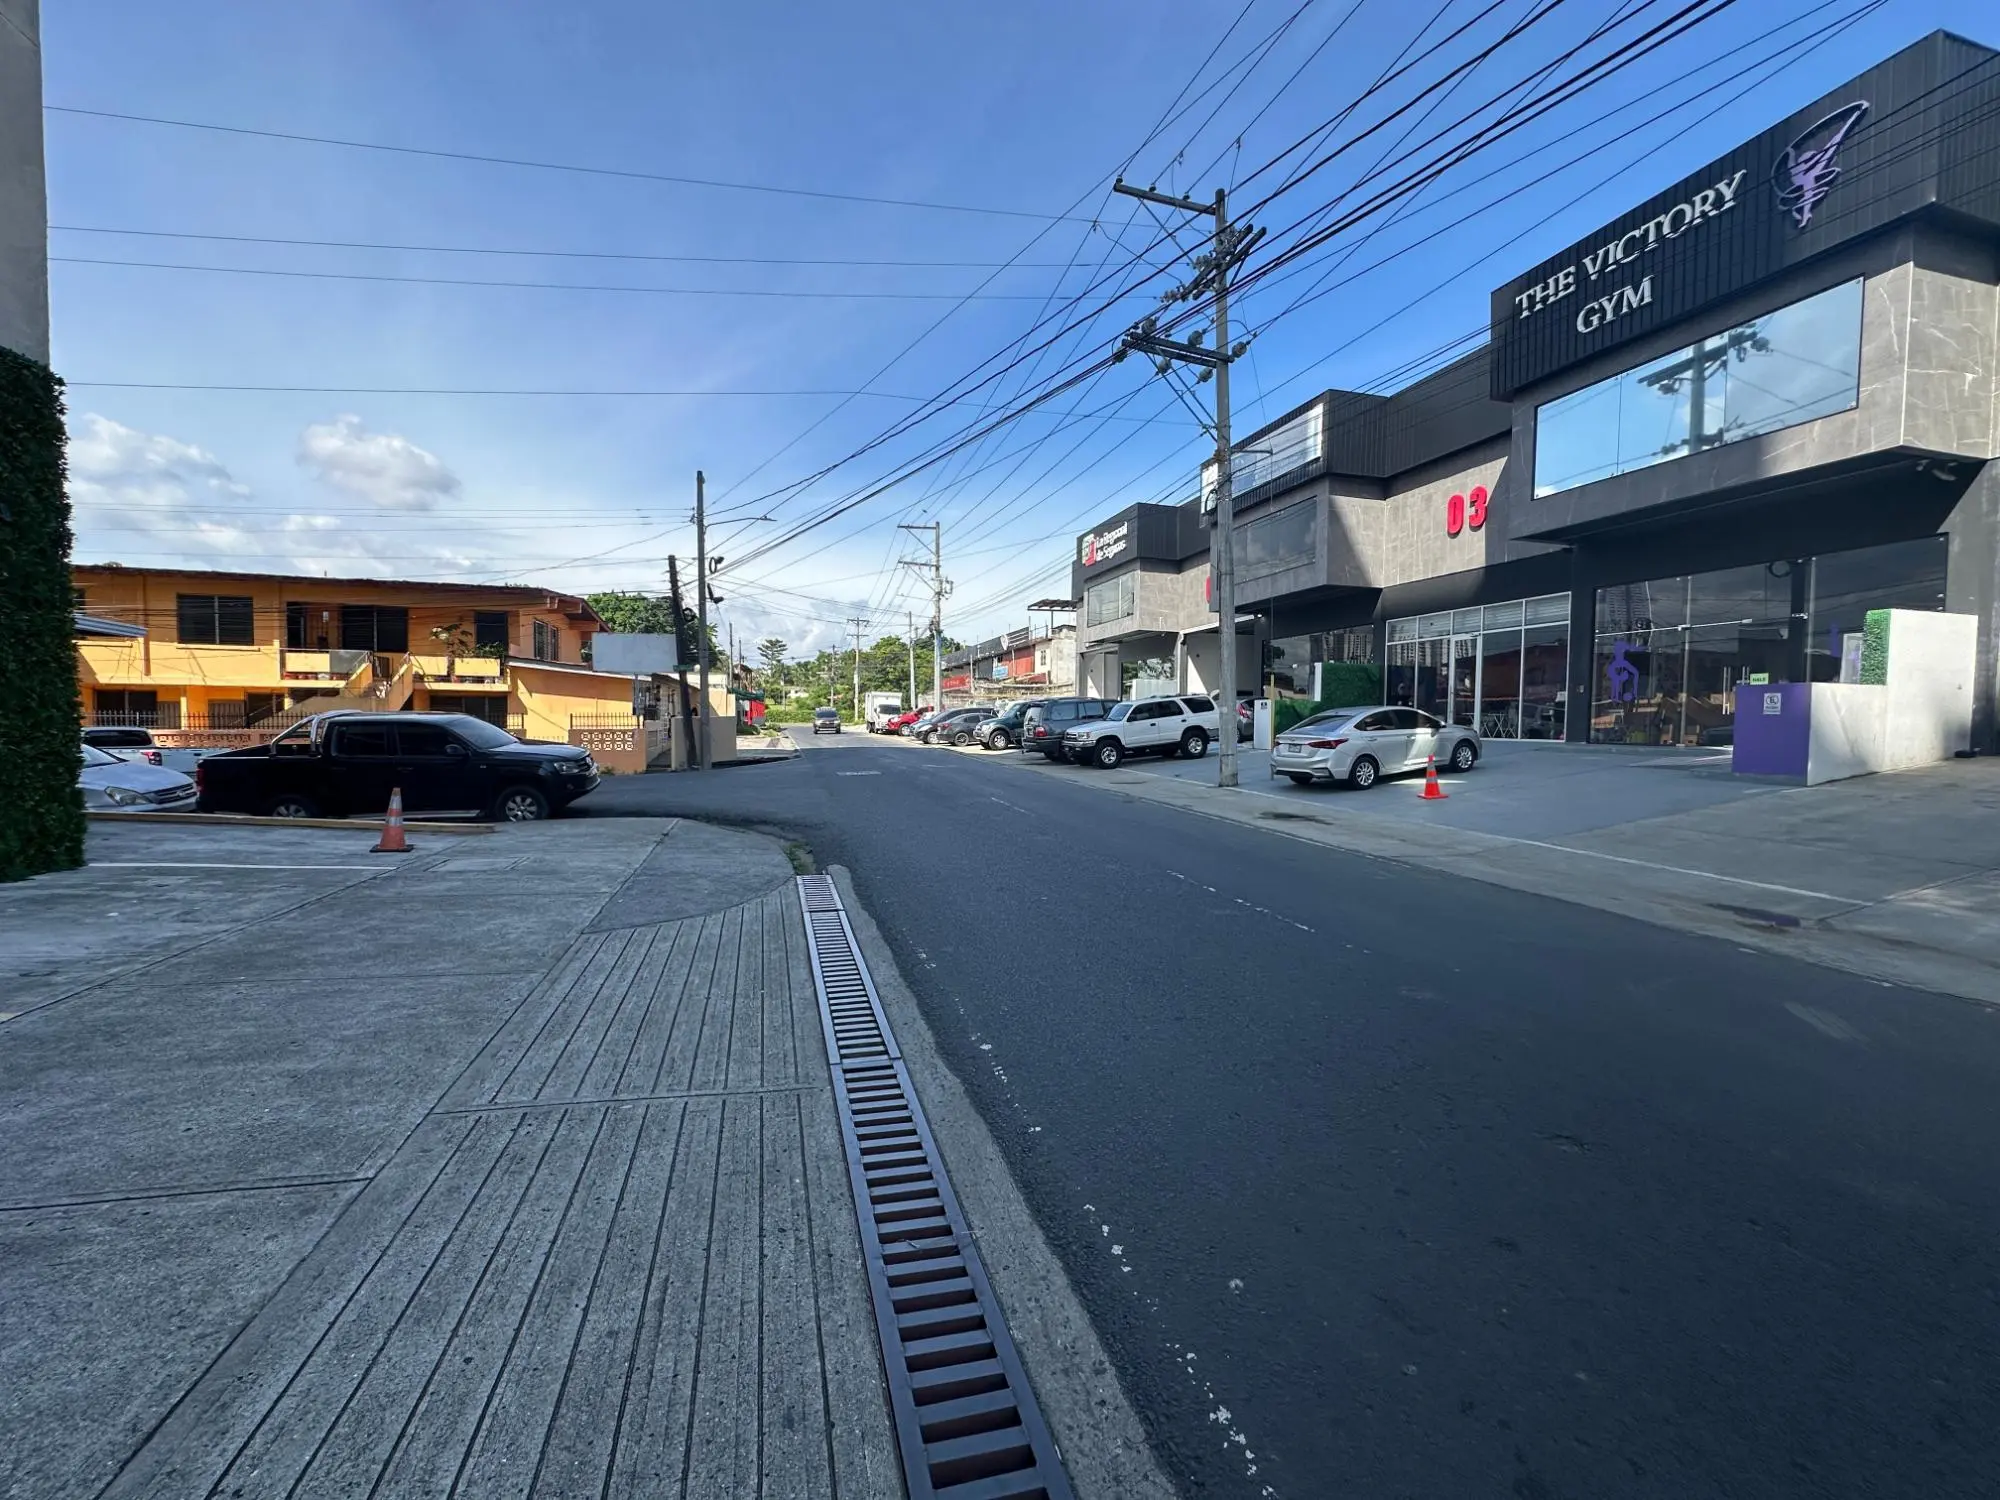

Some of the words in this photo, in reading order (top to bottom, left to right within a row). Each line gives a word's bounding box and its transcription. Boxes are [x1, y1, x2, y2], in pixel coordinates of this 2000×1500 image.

[1515, 265, 1576, 319] THE
[1582, 169, 1747, 281] VICTORY
[1576, 274, 1655, 334] GYM
[1446, 484, 1488, 535] 03
